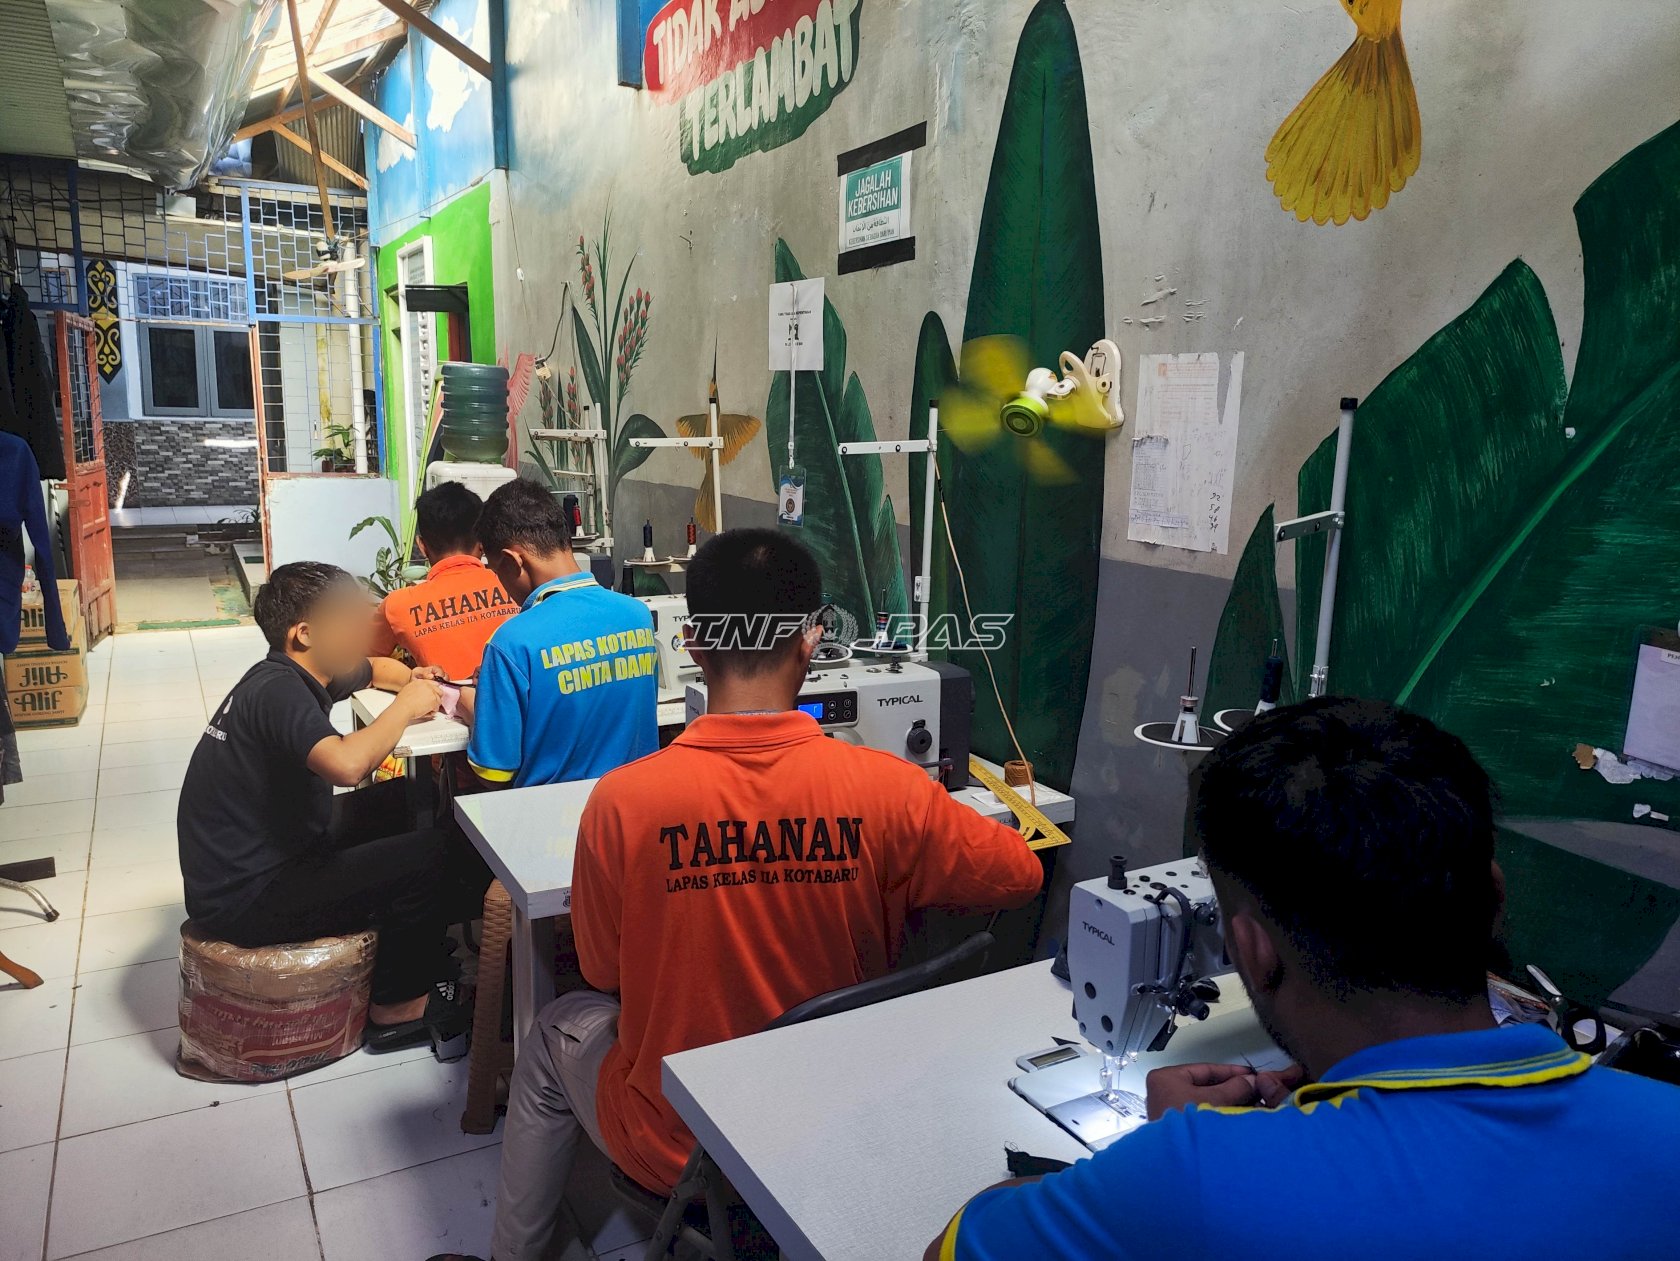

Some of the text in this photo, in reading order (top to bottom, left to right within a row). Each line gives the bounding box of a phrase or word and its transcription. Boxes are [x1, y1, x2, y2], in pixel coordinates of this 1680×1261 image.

[653, 0, 722, 85] TIDAK
[686, 0, 858, 161] TERLAMBAT
[855, 169, 892, 197] JAGALAH
[848, 187, 899, 218] KEBERSIHAN
[414, 625, 438, 638] LAPAS
[440, 617, 466, 631] KELAS
[540, 639, 596, 670] LAPAS
[19, 666, 68, 687] Alif
[557, 660, 612, 695] CINTA
[14, 691, 63, 712] Alif
[877, 695, 923, 707] TYPICAL
[659, 817, 863, 870] TAHANAN
[665, 875, 708, 893] LAPAS
[712, 869, 757, 888] KELAS
[783, 867, 859, 884] KOTABARU
[1082, 921, 1115, 946] TYPICAL
